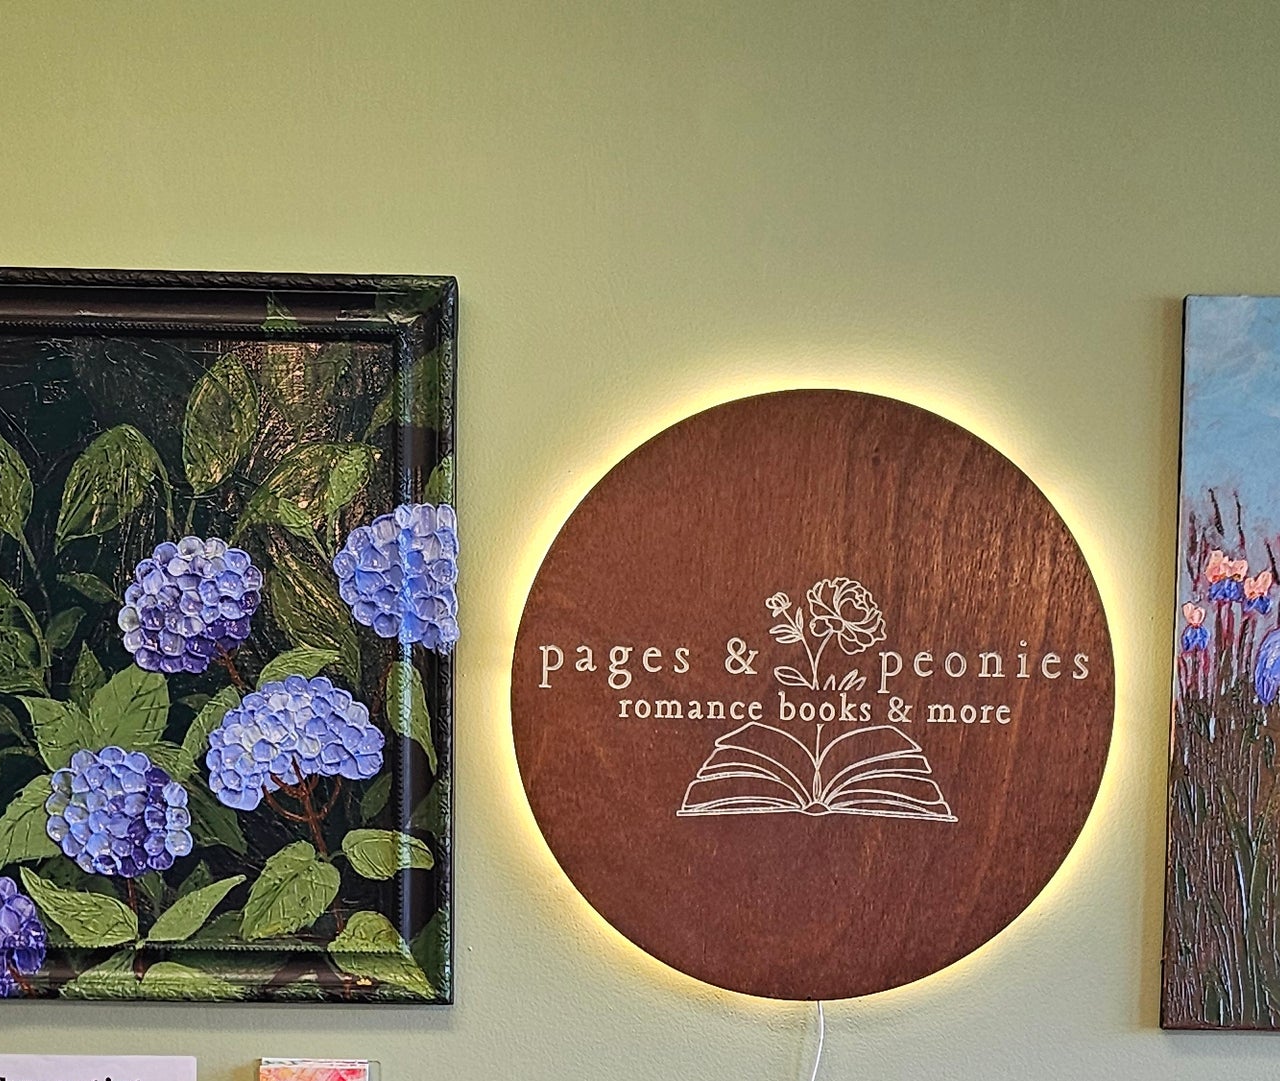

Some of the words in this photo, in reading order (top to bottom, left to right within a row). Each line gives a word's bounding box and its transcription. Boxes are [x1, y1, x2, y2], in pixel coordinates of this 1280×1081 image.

[538, 642, 690, 689] pages
[724, 637, 760, 675] &
[877, 640, 1090, 694] peonies
[618, 697, 763, 720] romance
[778, 692, 872, 723] books
[888, 698, 912, 723] &
[926, 702, 1012, 725] more
